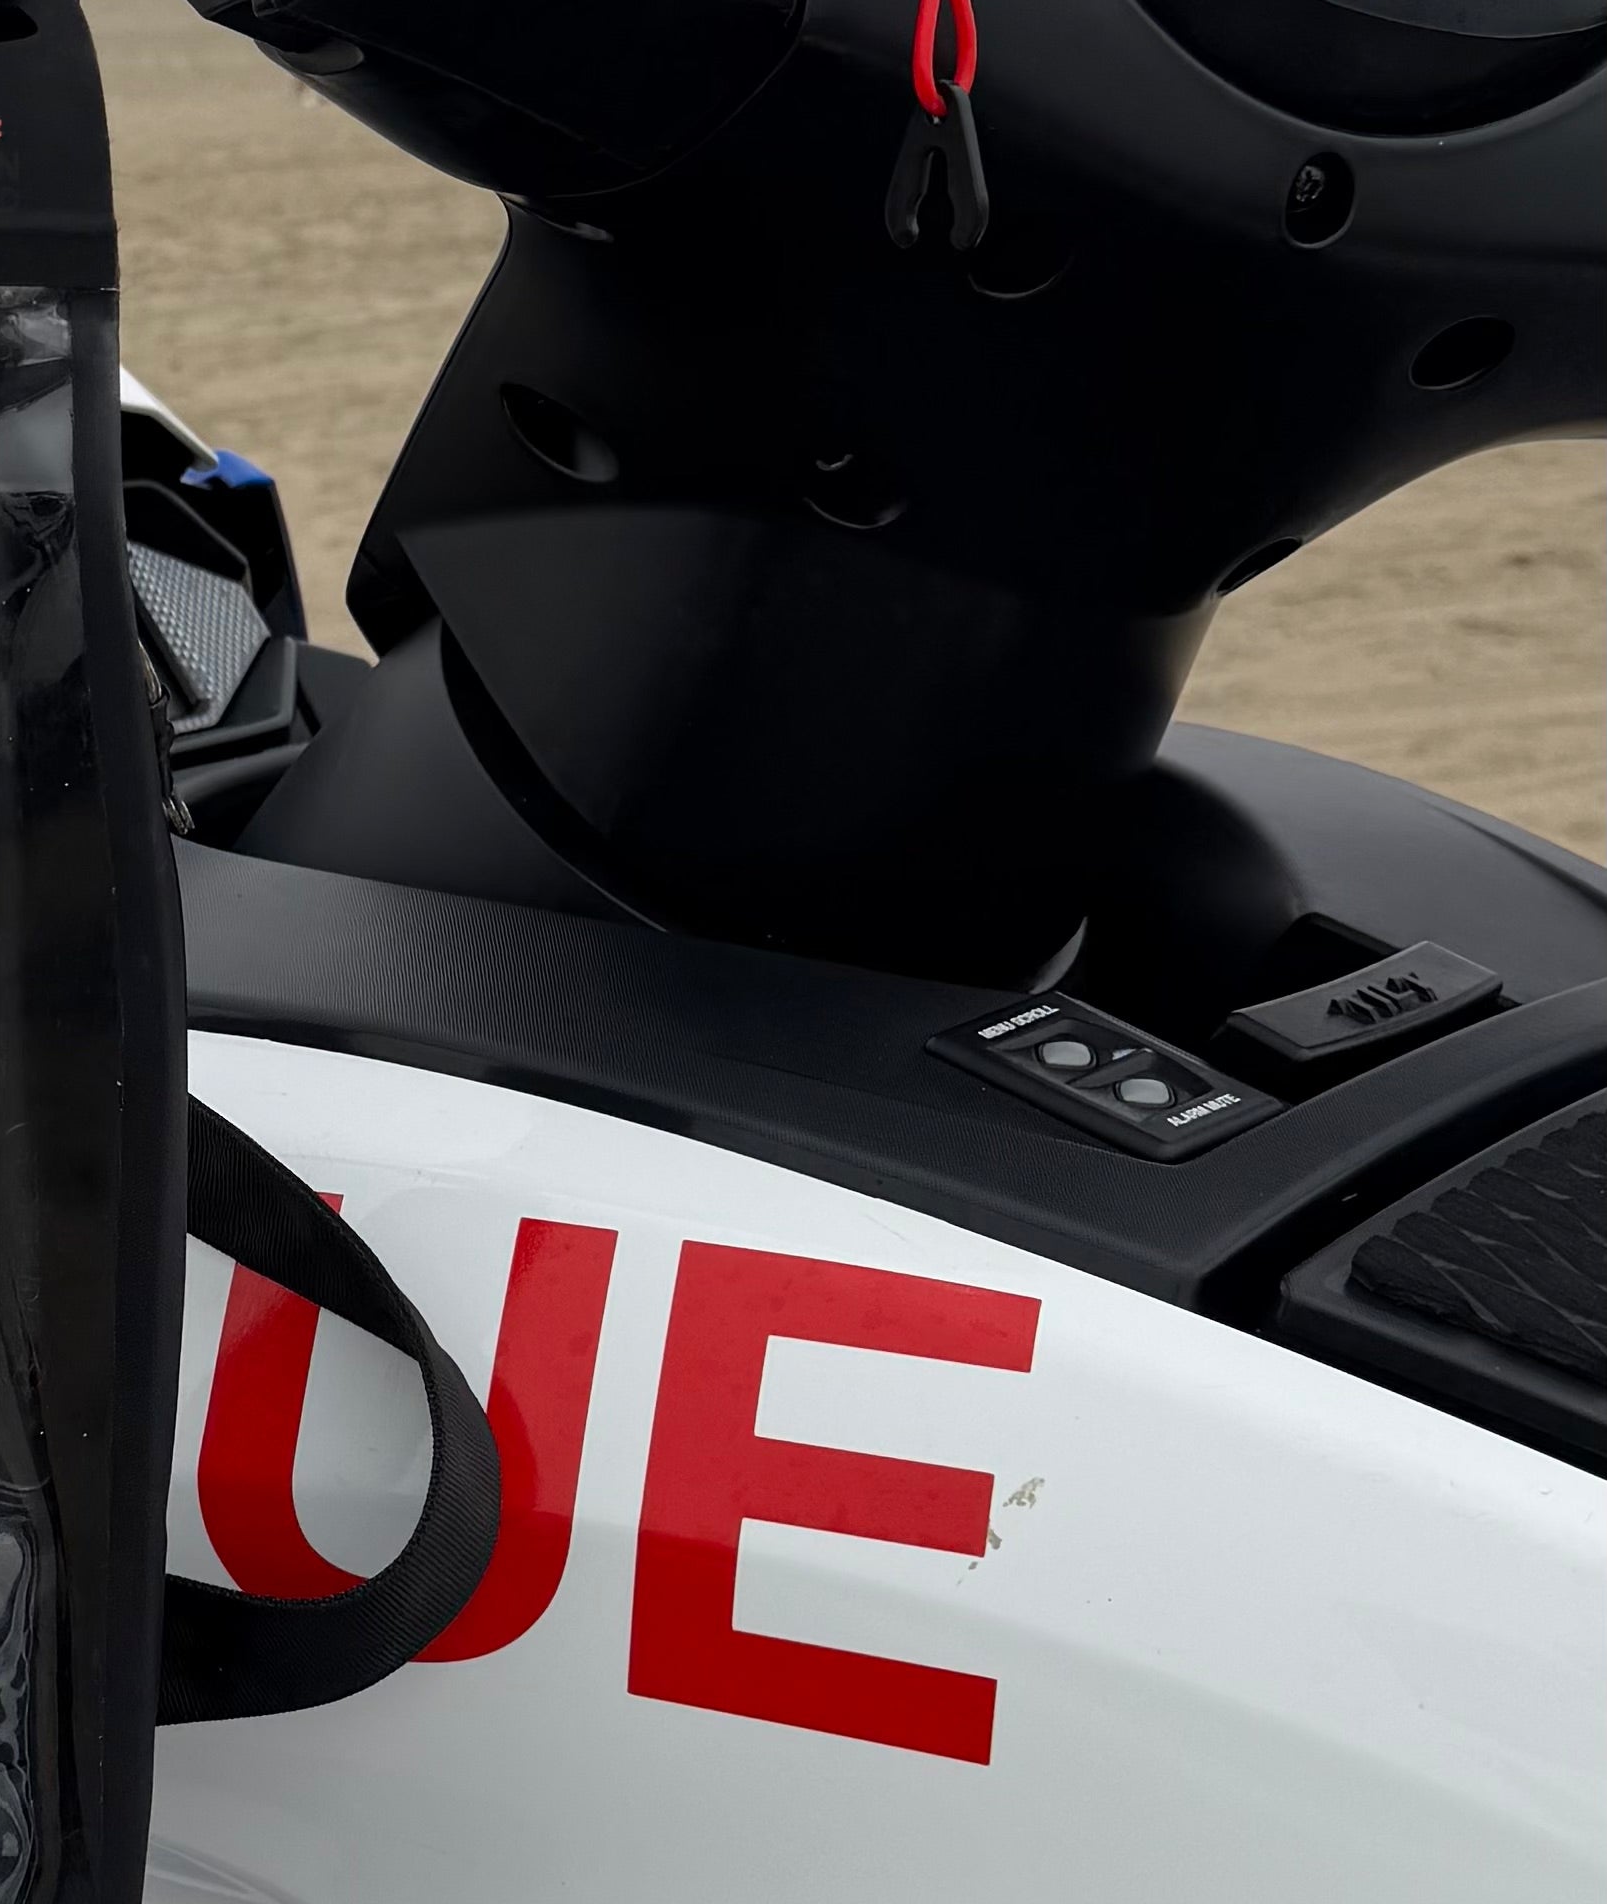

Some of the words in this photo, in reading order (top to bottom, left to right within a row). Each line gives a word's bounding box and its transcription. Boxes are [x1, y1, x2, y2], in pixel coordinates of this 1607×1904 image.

[977, 1020, 1016, 1040] MENU
[1010, 1004, 1060, 1027] SCROLL
[1166, 1105, 1213, 1128] ALARM
[1202, 1093, 1242, 1112] MUTE
